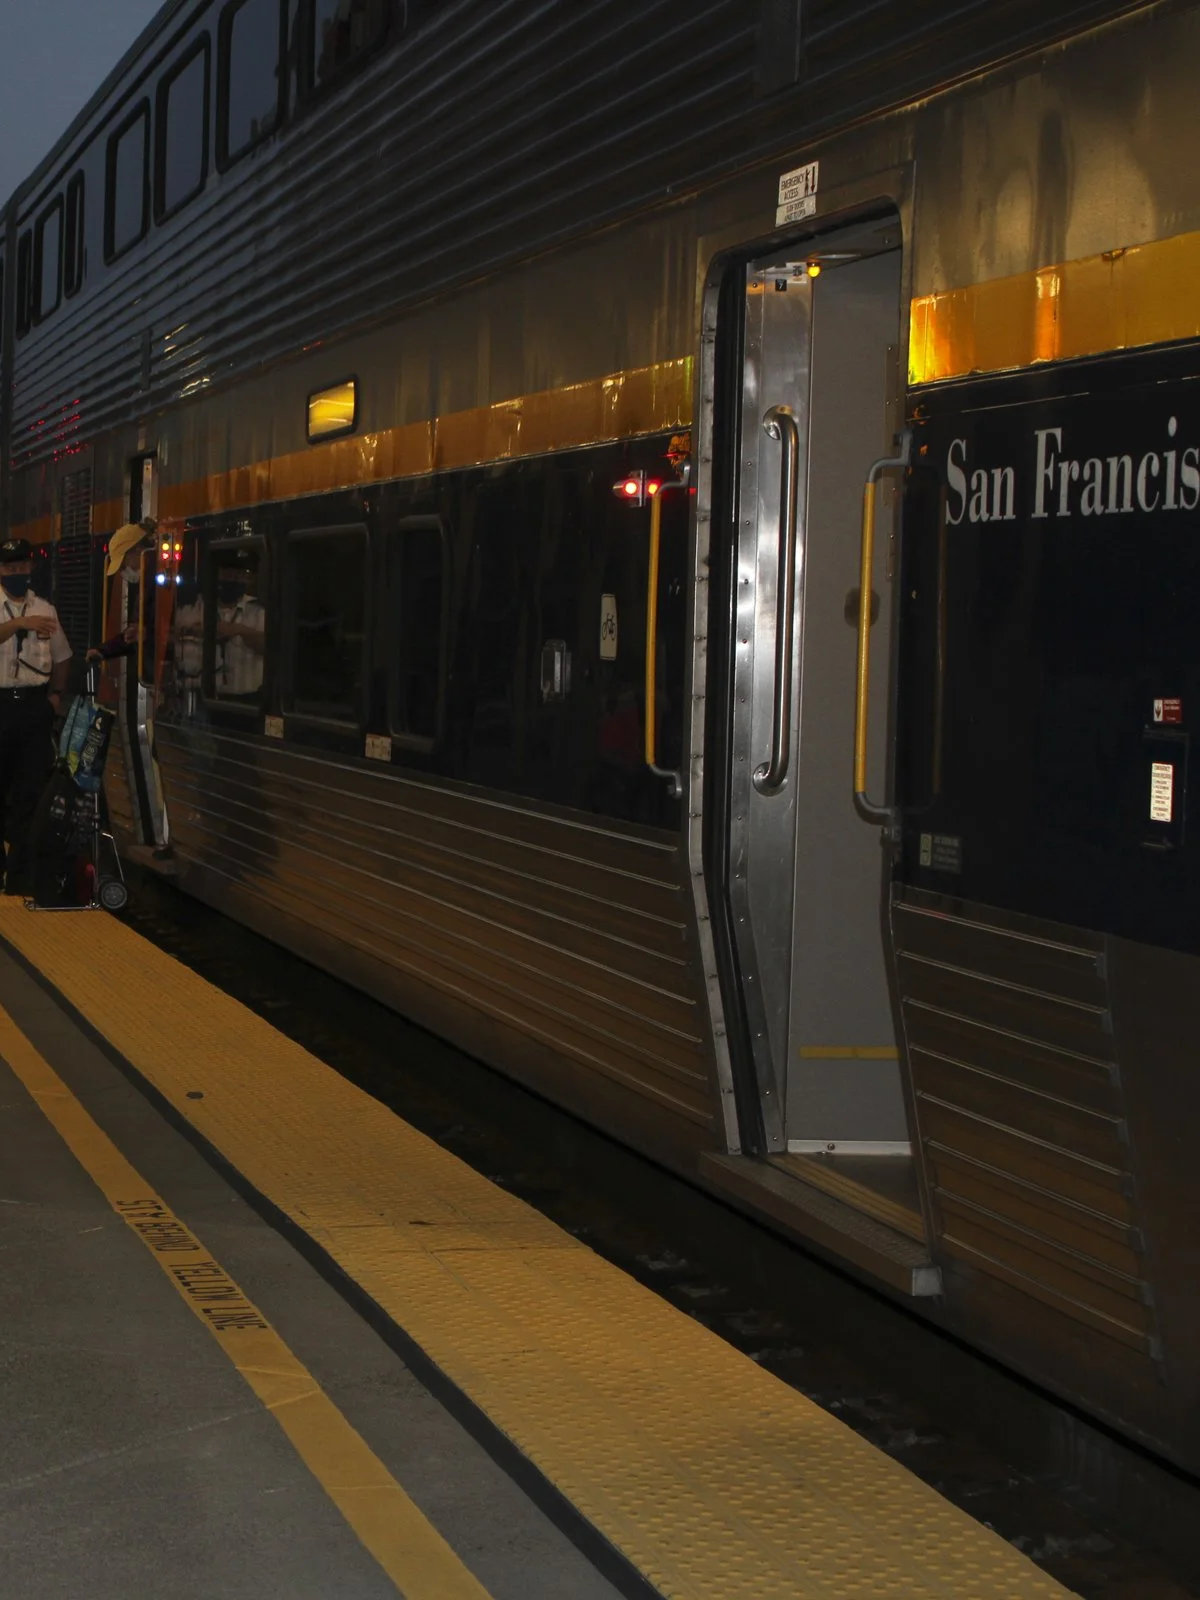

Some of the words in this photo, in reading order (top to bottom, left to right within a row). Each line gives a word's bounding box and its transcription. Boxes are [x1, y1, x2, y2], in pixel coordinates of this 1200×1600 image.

[781, 174, 804, 190] EMERGENCY
[784, 187, 798, 201] ACCESS
[945, 438, 1017, 526] San
[1031, 415, 1200, 519] Francis
[135, 1221, 201, 1252] BEHIND
[168, 1261, 244, 1302] YELLOW
[202, 1306, 268, 1331] LINE
